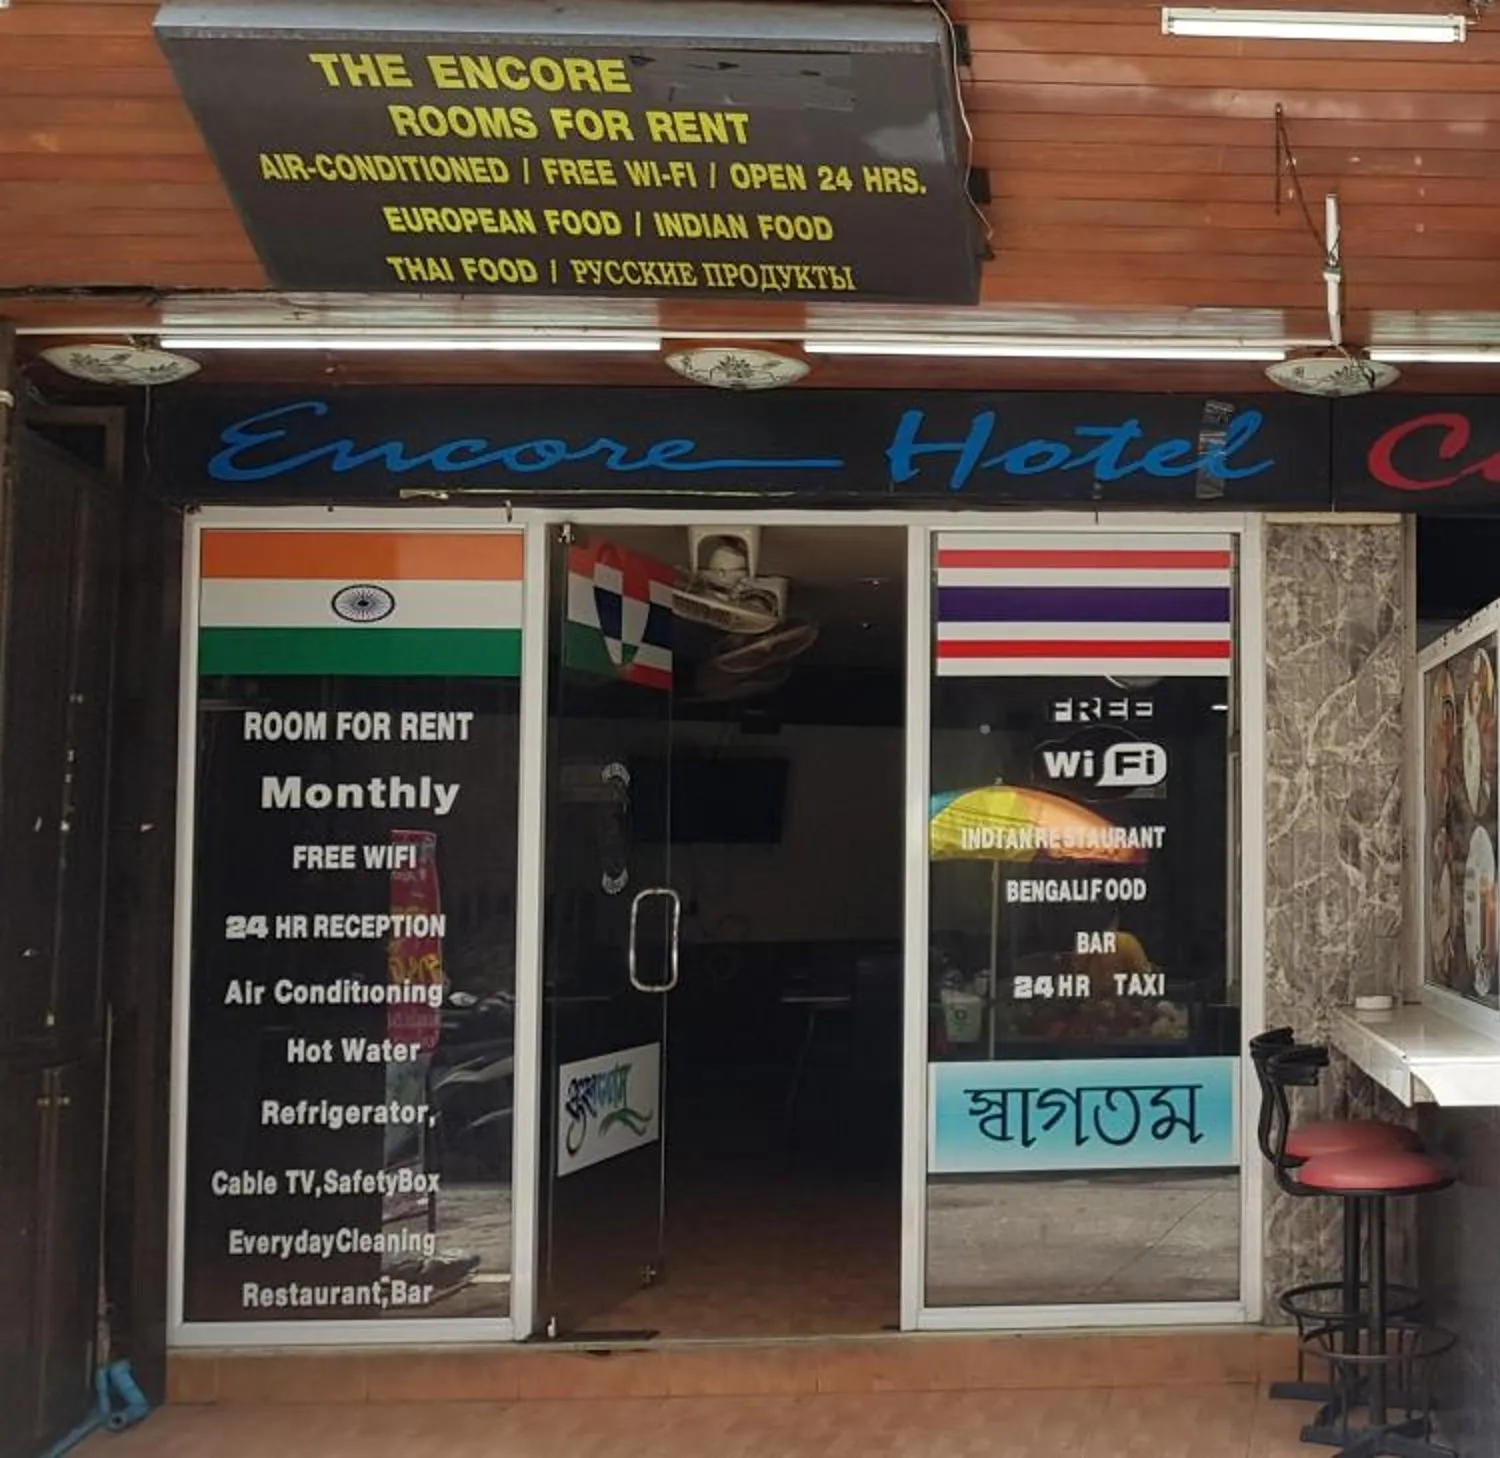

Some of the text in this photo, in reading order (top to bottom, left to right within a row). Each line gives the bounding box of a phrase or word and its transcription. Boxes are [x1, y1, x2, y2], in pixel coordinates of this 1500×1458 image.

[313, 52, 633, 93] THE ENCORE
[388, 104, 749, 145] ROOMS FOR RENT
[259, 153, 510, 184] AIR-CONDITIONED
[541, 157, 618, 186] FREE
[629, 160, 697, 189] WI-FI
[729, 161, 808, 191] OPEN
[817, 165, 853, 192] 24
[862, 165, 925, 195] HRS.
[383, 206, 538, 234] EUROPEAN
[543, 209, 623, 236] FOOD
[655, 211, 749, 239] INDIAN
[756, 214, 834, 241] FOOD
[388, 256, 454, 281] THAI
[461, 257, 538, 283] FOOD
[572, 259, 855, 290] РУССКИЕ ПРОДУКТЫ
[207, 400, 1275, 490] Encore Hotel
[1055, 698, 1153, 722] FREE
[244, 711, 474, 741] ROOM FOR RENT
[262, 776, 460, 815] Monthly
[293, 845, 417, 870] FREE WIFI
[225, 915, 445, 939] 24 HR RECEPTION
[1077, 932, 1116, 953] BAR
[224, 979, 443, 1007] Air Conditioning
[1113, 974, 1166, 996] TAXI
[287, 1037, 421, 1063] Hot Water
[262, 1100, 436, 1128] Refrigerator,
[964, 1084, 1204, 1148] স্বাগতম
[212, 1170, 277, 1195] Cable
